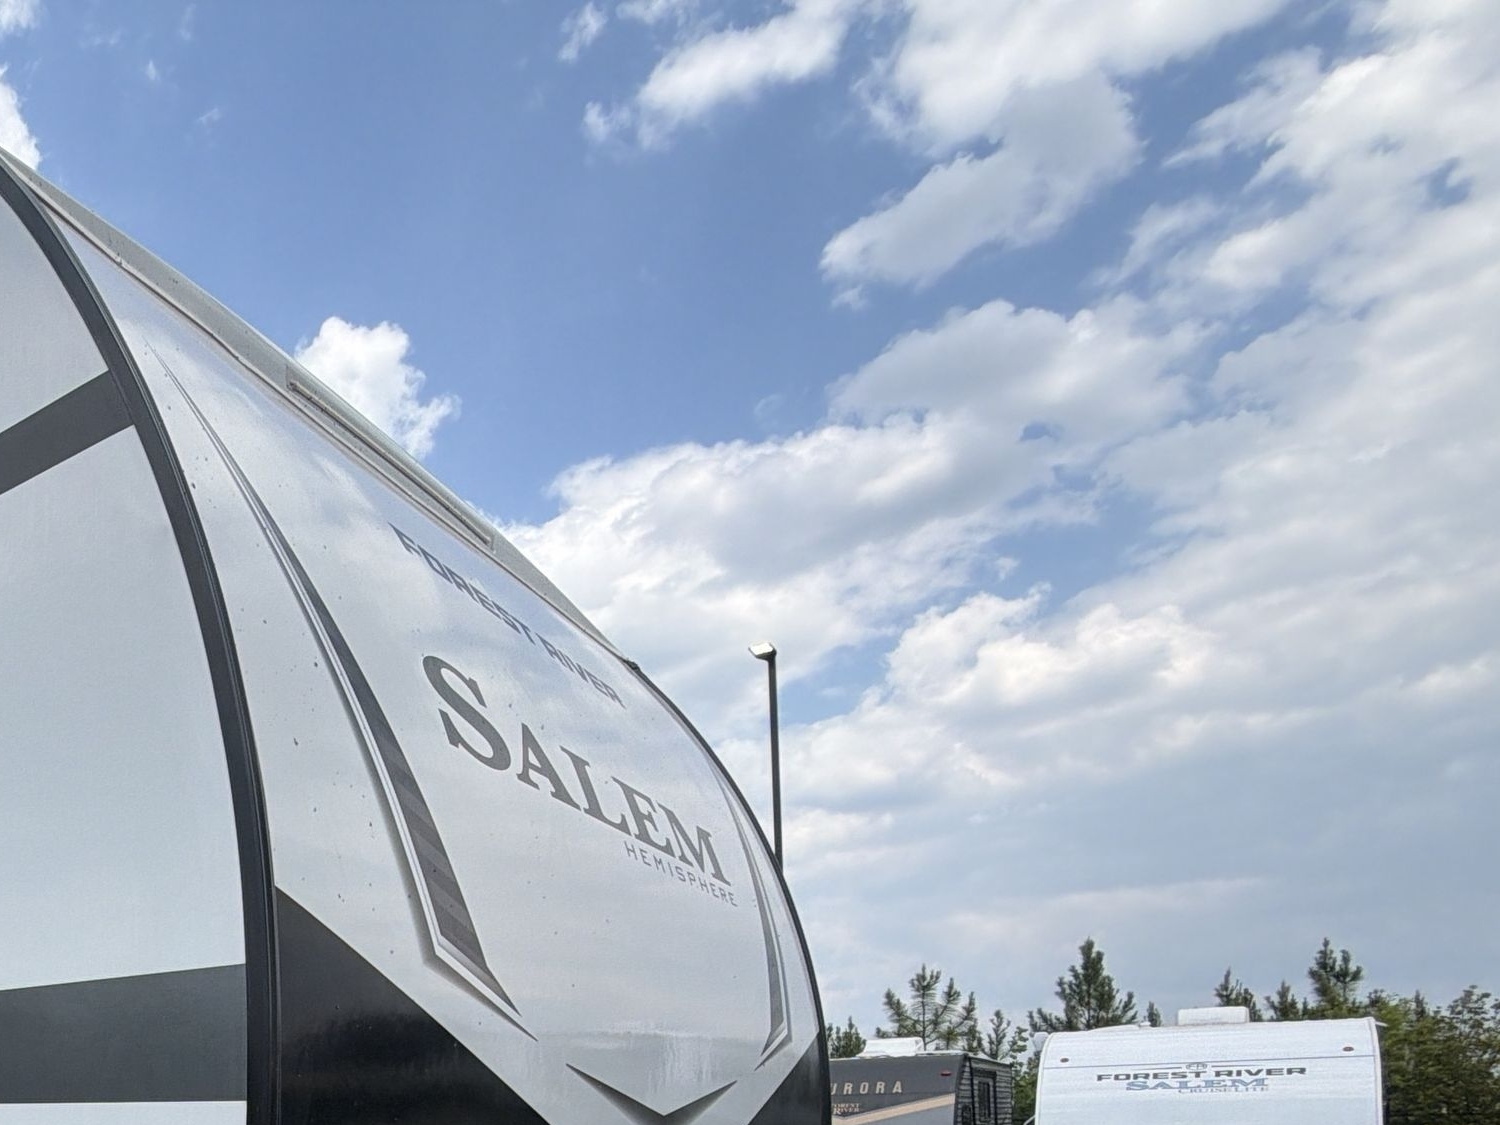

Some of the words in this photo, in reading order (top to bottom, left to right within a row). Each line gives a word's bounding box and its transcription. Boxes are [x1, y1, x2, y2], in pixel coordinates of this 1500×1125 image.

[388, 521, 536, 646] FOREST
[534, 631, 627, 709] RIVER
[422, 655, 731, 887] SALEM
[624, 841, 738, 907] HEMISPHERE
[830, 1080, 903, 1096] URORA
[1096, 1071, 1207, 1082] FOREST
[1214, 1067, 1307, 1078] RIVER
[1125, 1077, 1269, 1092] SALEM
